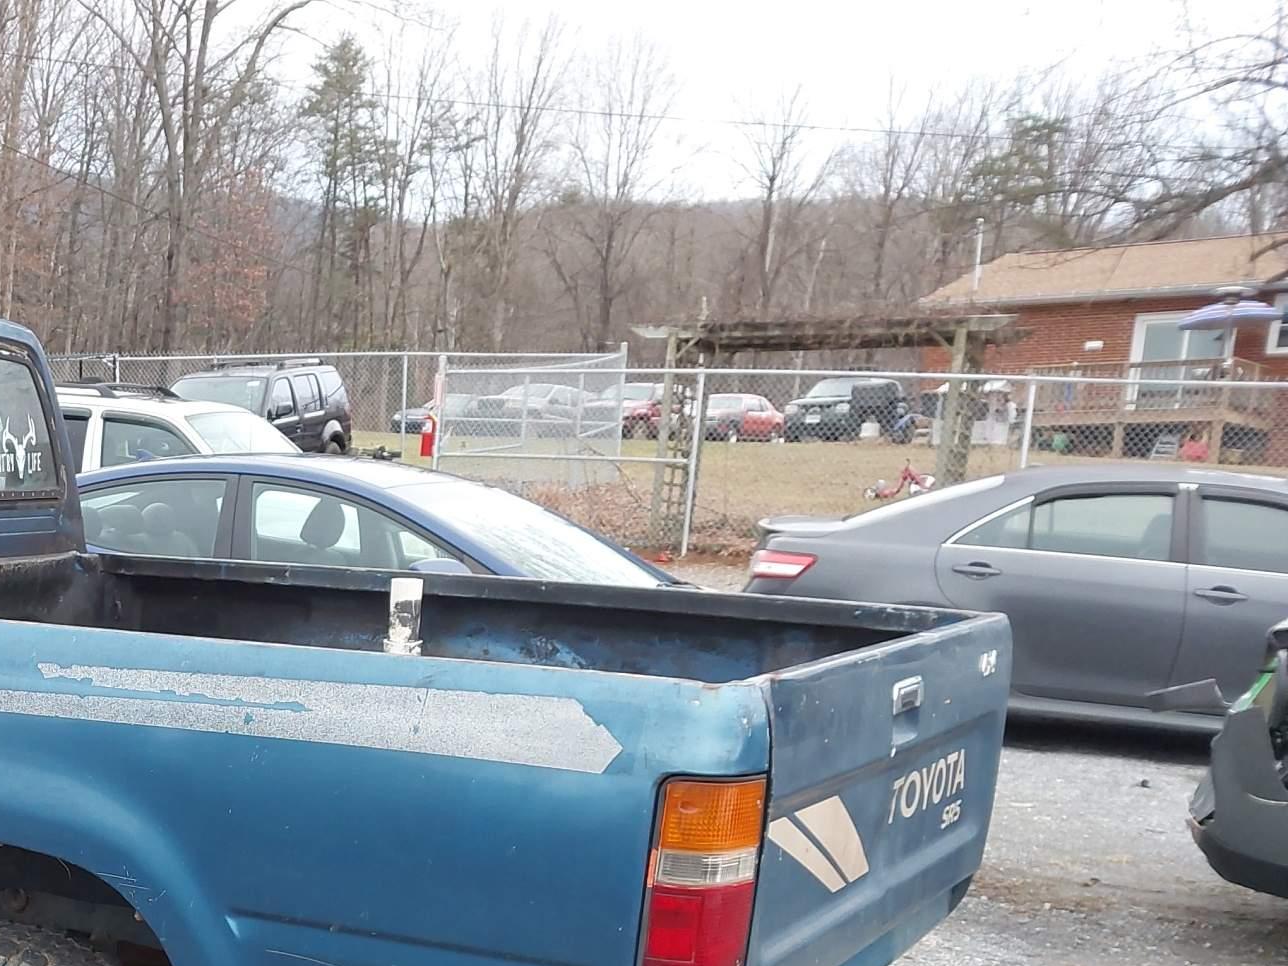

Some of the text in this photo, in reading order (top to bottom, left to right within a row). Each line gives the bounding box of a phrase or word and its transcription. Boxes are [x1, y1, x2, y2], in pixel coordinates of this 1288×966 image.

[27, 452, 42, 474] LIFE
[888, 748, 965, 824] TOYOTA
[940, 799, 963, 830] SR5
